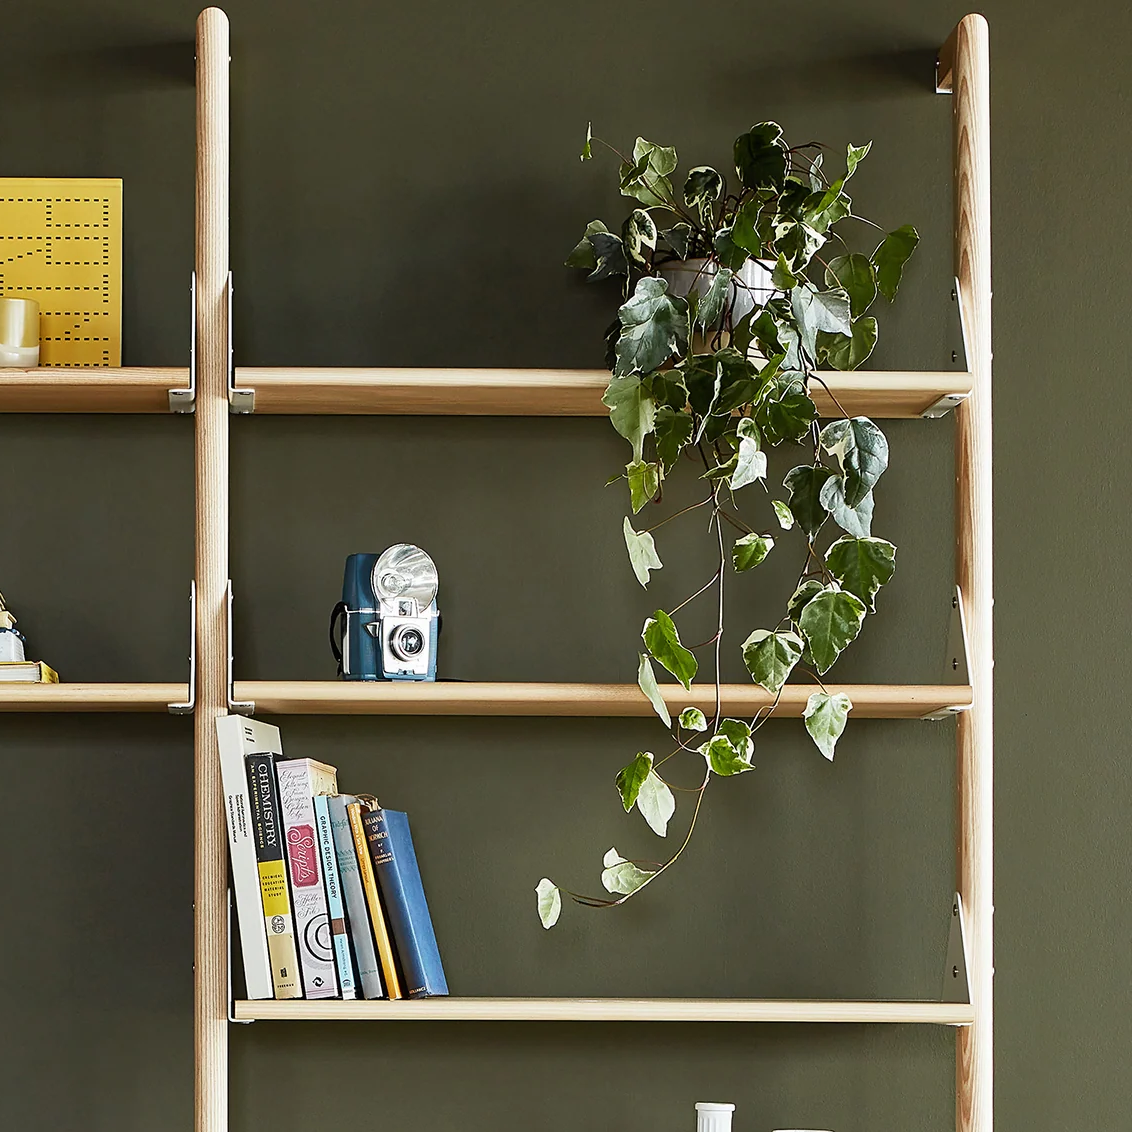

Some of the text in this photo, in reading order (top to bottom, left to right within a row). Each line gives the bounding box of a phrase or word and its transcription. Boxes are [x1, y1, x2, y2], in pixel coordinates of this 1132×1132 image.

[250, 764, 255, 774] AN
[252, 776, 261, 820] EXPERIMENTAL
[258, 763, 277, 847] CHEMISTRY
[287, 828, 314, 882] Scripts
[320, 816, 337, 898] GRAPHIC DESIGN THEORY
